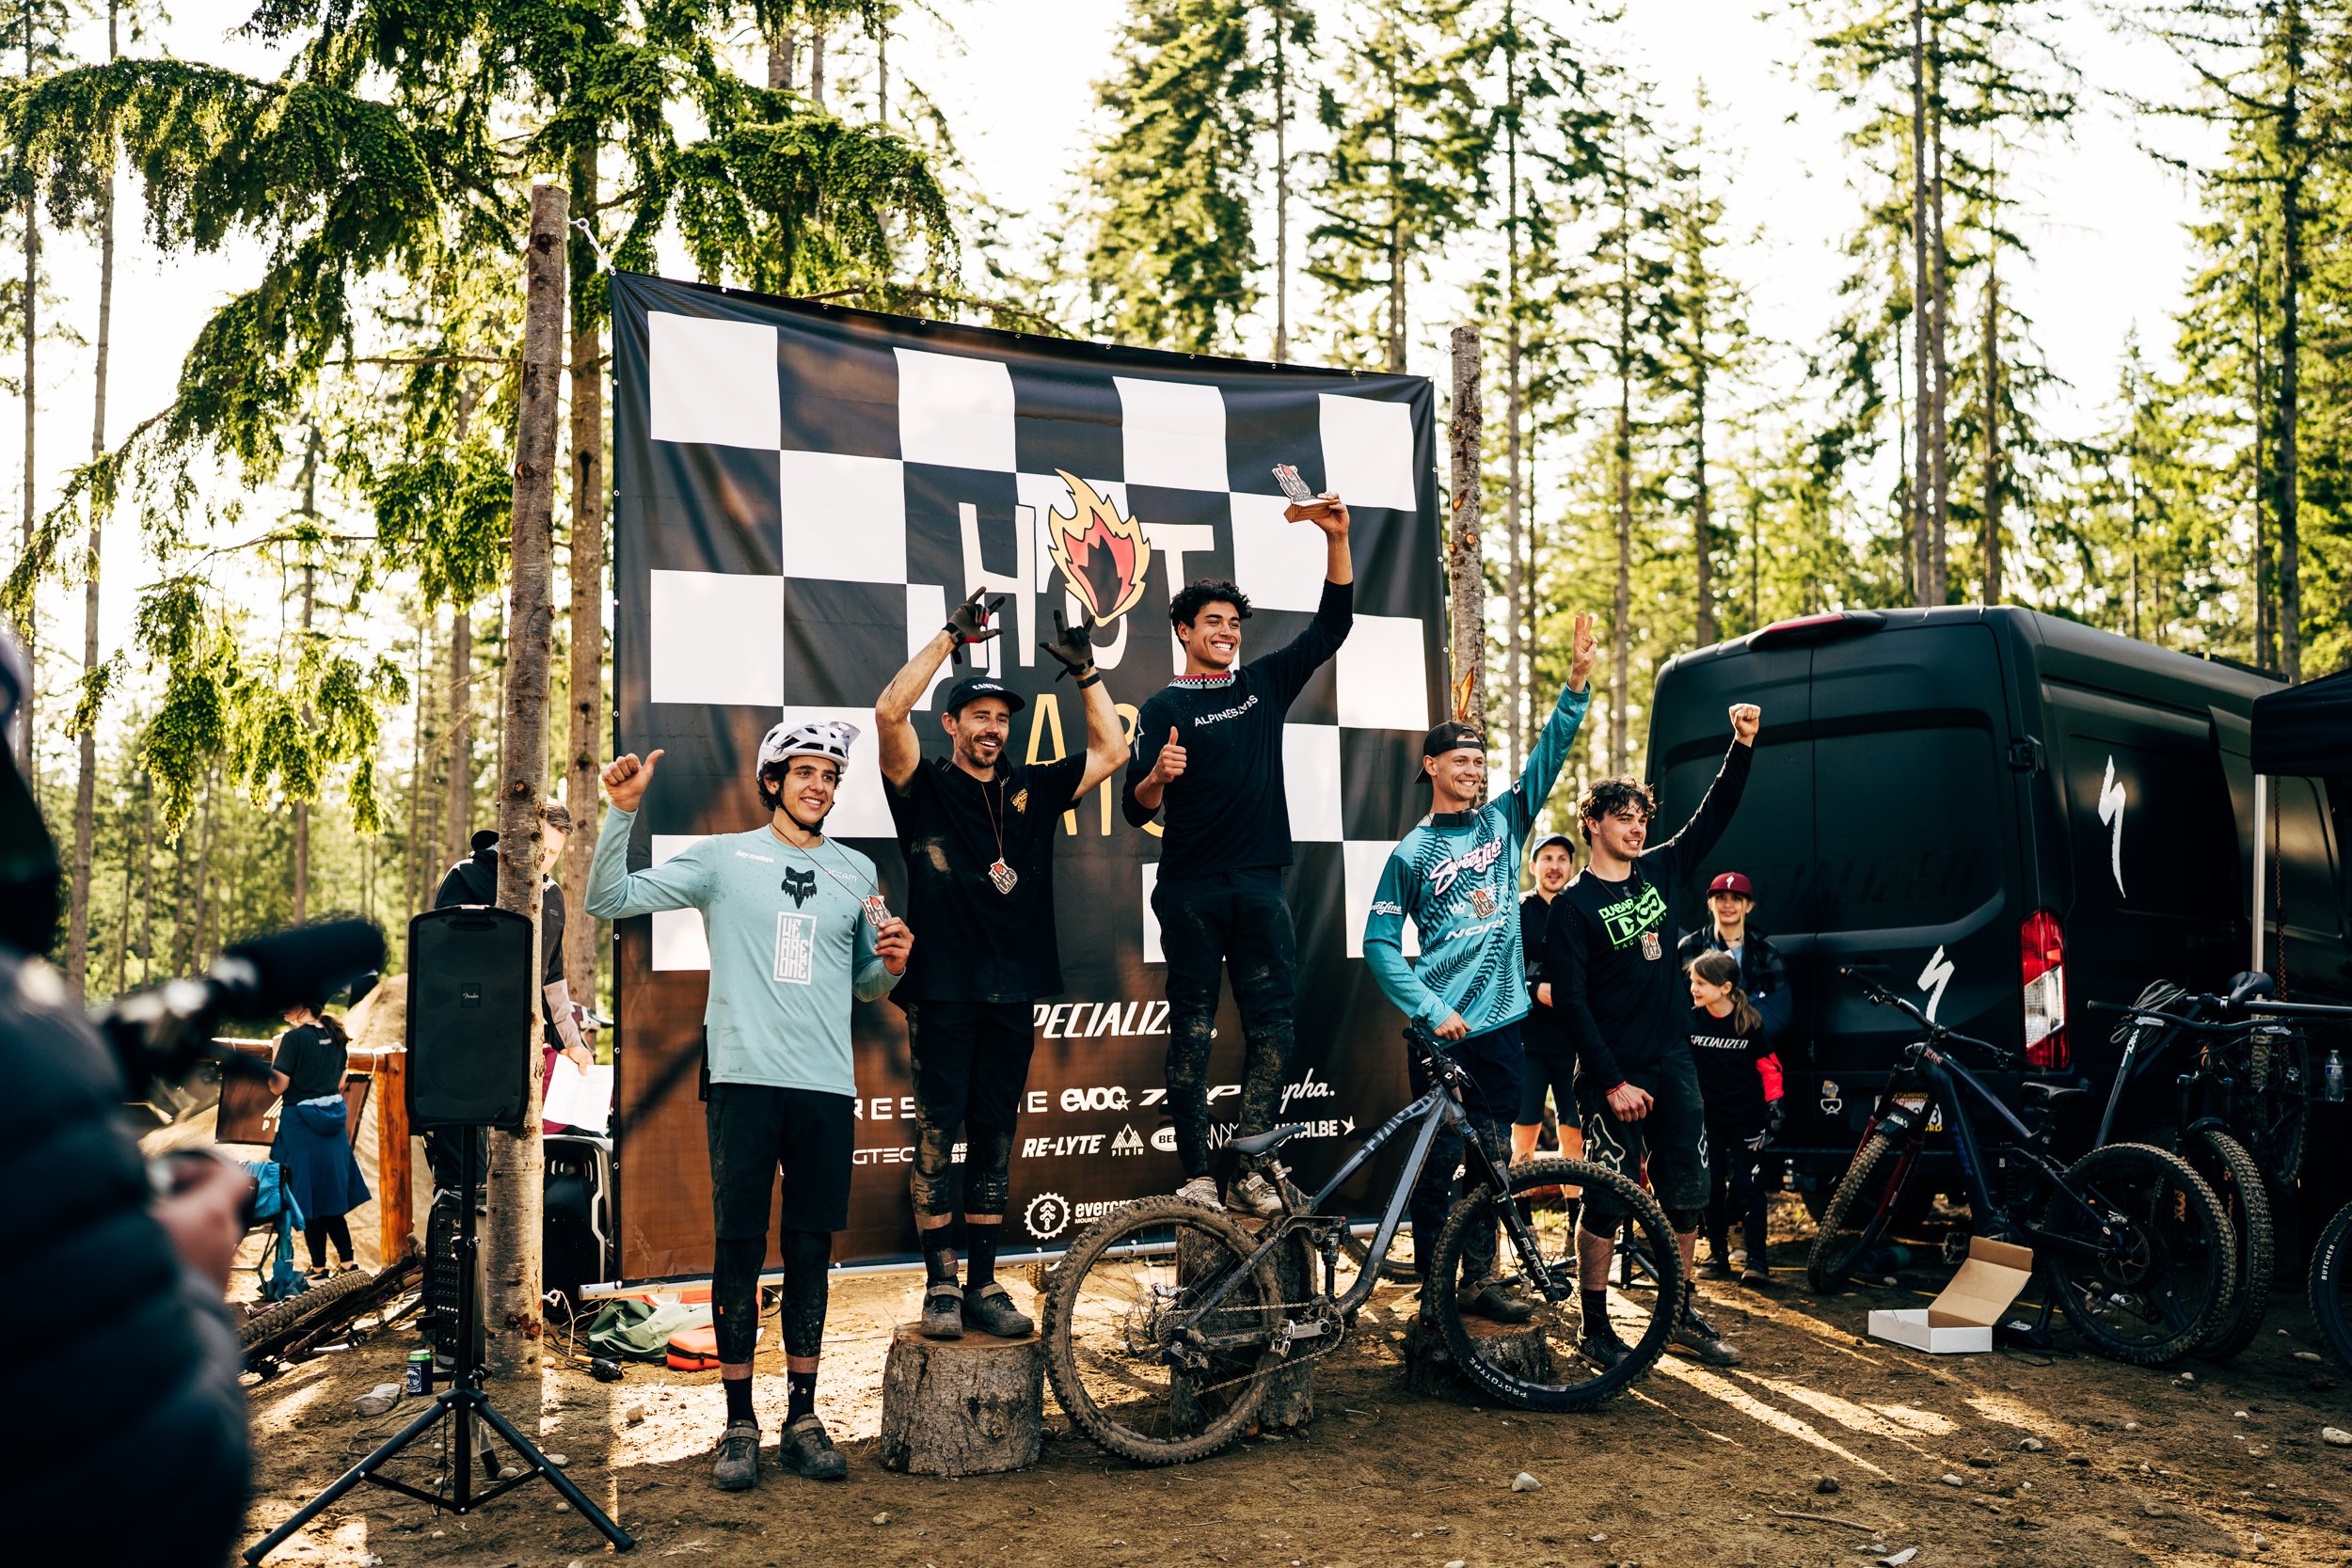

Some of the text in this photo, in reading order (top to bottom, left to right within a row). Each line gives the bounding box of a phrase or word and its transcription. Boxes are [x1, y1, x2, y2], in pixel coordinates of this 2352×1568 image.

[782, 917, 803, 940] WE
[780, 940, 809, 959] ARE
[778, 958, 808, 980] ONE
[1691, 1035, 1749, 1049] SPECIALIZED
[1022, 1134, 1105, 1158] RE-LYTE
[2321, 1244, 2336, 1281] BUTCHER
